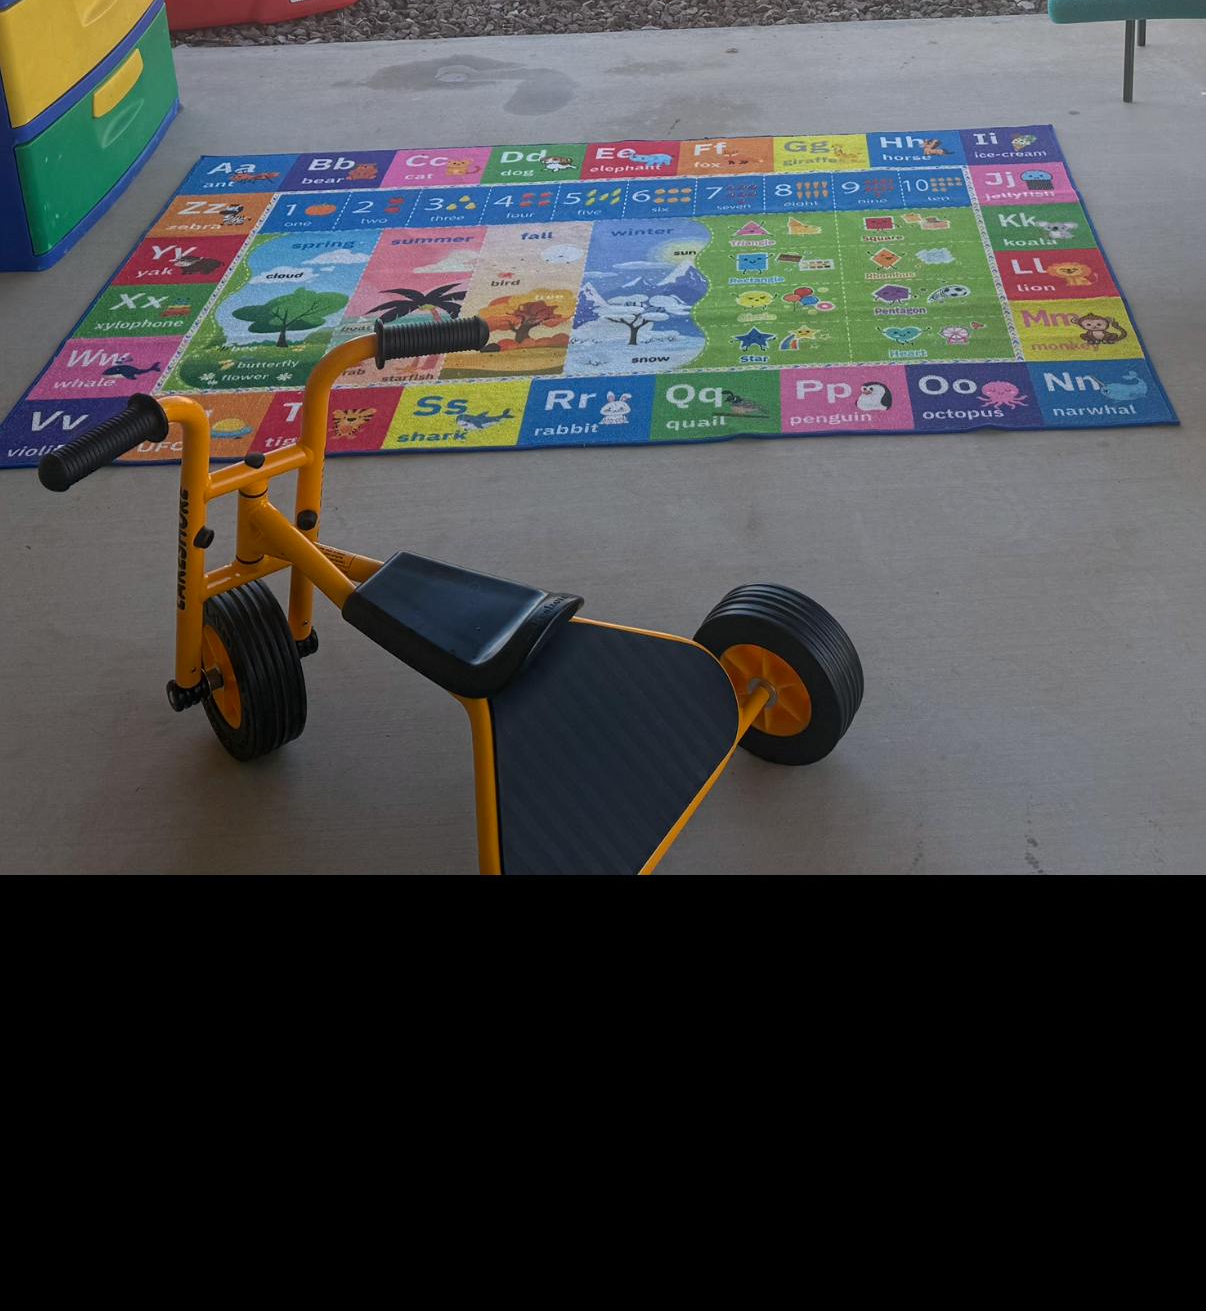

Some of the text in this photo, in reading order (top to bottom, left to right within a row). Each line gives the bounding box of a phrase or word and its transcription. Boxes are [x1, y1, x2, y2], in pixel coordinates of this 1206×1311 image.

[880, 136, 926, 148] Hh
[973, 132, 998, 145] Ii
[595, 147, 636, 160] Ee
[694, 141, 727, 156] Ff
[784, 140, 831, 155] Gg
[500, 149, 547, 163] Dd
[882, 153, 932, 162] horse
[975, 150, 1047, 158] ice-cream
[308, 157, 356, 171] Bb
[405, 155, 449, 167] Cc
[694, 161, 721, 169] fox
[783, 157, 837, 167] giraffe
[207, 161, 256, 175] Aa
[500, 168, 535, 178] dog
[589, 163, 662, 174] elephant
[301, 175, 345, 185] bear
[404, 171, 434, 180] cat
[984, 171, 1016, 188] Jj
[202, 179, 235, 188] ant
[841, 181, 860, 194] 9
[903, 179, 929, 192] 10
[632, 189, 650, 202] 6
[705, 186, 724, 199] 7
[775, 184, 793, 197] 8
[984, 190, 1056, 202] jellyfish
[424, 197, 444, 211] 3
[493, 195, 514, 208] 4
[563, 192, 581, 205] 5
[783, 200, 818, 209] eight
[177, 201, 224, 215] Zz
[286, 204, 297, 216] 1
[352, 201, 375, 213] 2
[577, 208, 602, 216] five
[284, 220, 312, 228] one
[360, 217, 388, 225] two
[430, 214, 465, 222] three
[998, 213, 1037, 227] Kk
[166, 222, 222, 231] zebra
[611, 227, 675, 237] winter
[391, 235, 475, 245] summer
[520, 231, 554, 240] fall
[291, 239, 357, 249] spring
[1003, 238, 1058, 247] koala
[152, 245, 198, 261] Yy
[135, 267, 173, 279] yak
[265, 272, 305, 280] cloud
[491, 279, 521, 287] bird
[1017, 283, 1056, 292] lion
[110, 293, 169, 311] Xx
[874, 306, 927, 316] Pentagon
[1020, 309, 1077, 328] Mm
[95, 319, 184, 331] xylophone
[1031, 340, 1100, 352] monkey
[67, 349, 126, 368] Ww
[237, 359, 300, 369] butterfly
[740, 355, 769, 363] Star
[222, 373, 270, 381] flower
[342, 367, 366, 377] rab
[381, 373, 435, 383] starfish
[53, 377, 116, 389] whale
[918, 375, 978, 395] Oo
[1043, 372, 1104, 392] Nn
[666, 384, 723, 408] Qq
[796, 380, 851, 404] Pp
[413, 396, 468, 417] Ss
[544, 390, 597, 411] Rr
[922, 407, 1004, 421] octopus
[1053, 403, 1137, 417] narwhal
[31, 411, 89, 432] Vv
[666, 415, 728, 431] quail
[790, 412, 872, 426] penguin
[534, 423, 599, 437] rabbit
[397, 431, 468, 444] shark
